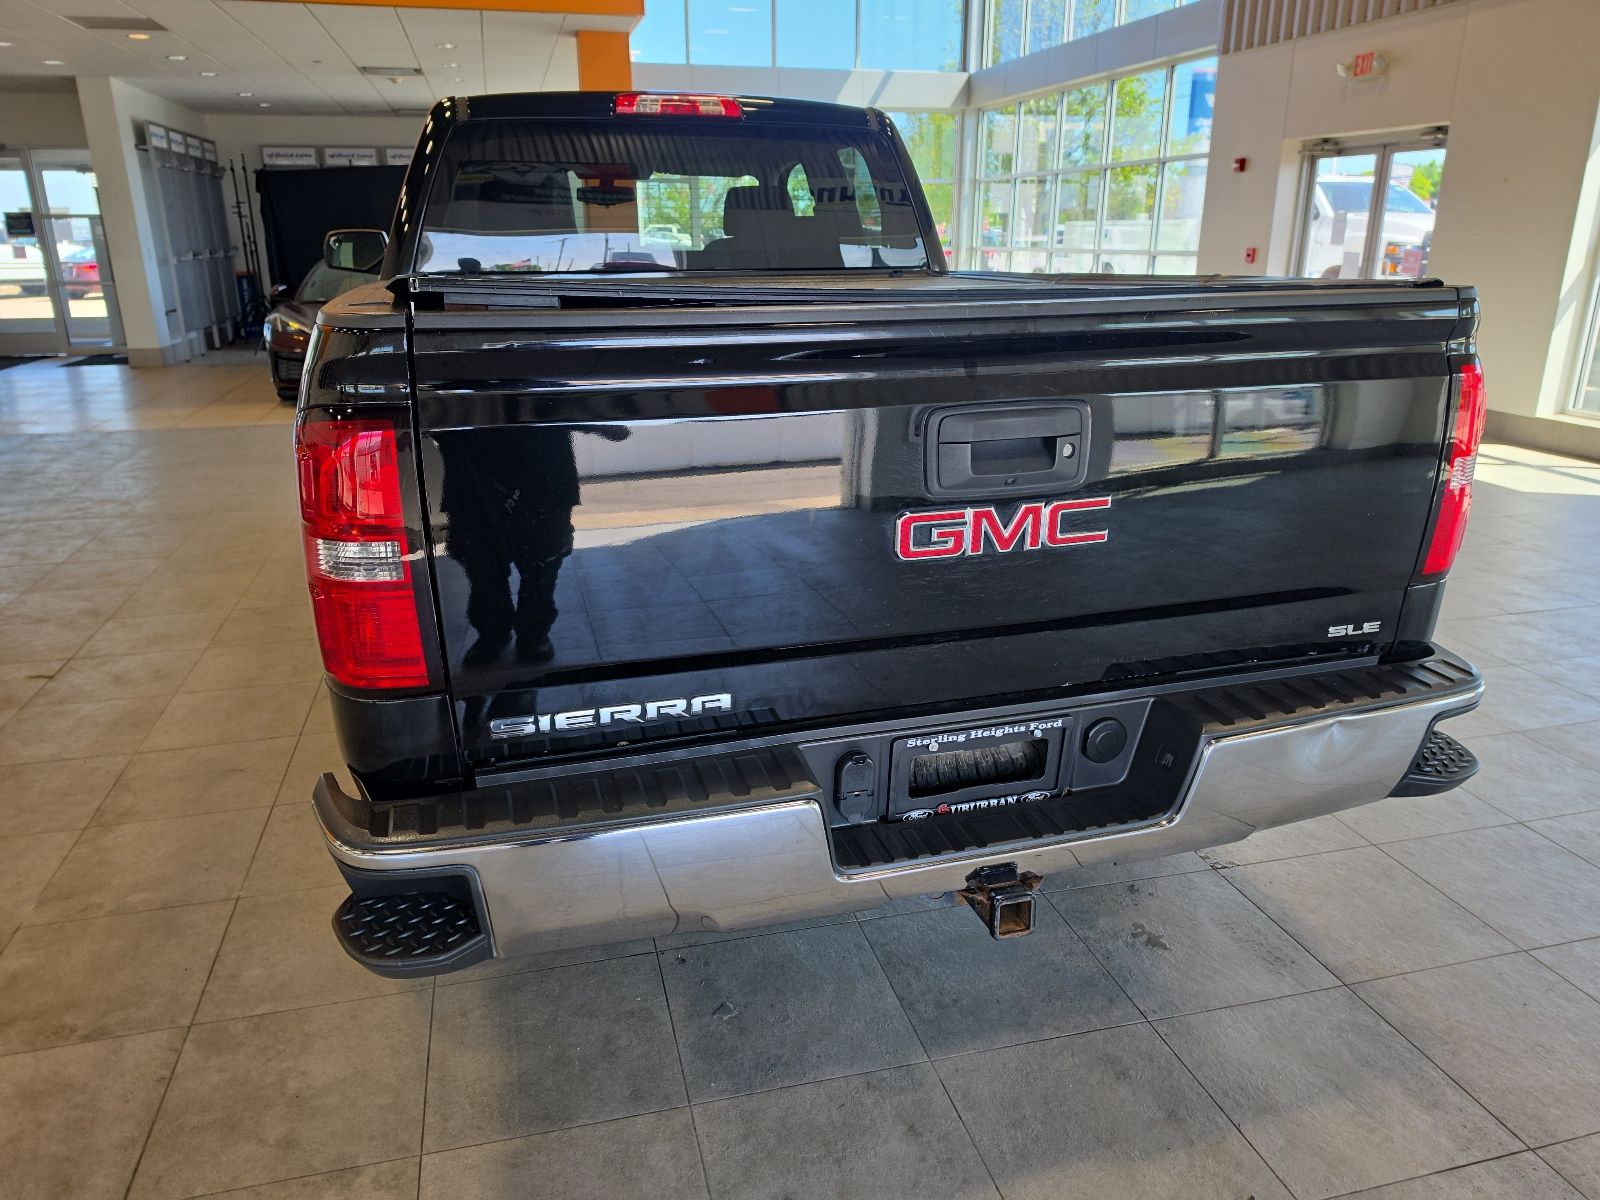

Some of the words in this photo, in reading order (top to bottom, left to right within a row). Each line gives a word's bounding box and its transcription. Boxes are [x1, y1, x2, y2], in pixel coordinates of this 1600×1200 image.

[1353, 52, 1377, 77] EXIT
[896, 496, 1111, 560] GMC
[1327, 621, 1381, 637] SLE
[489, 693, 732, 740] SIERRA
[907, 733, 967, 748] Sterling
[970, 725, 1026, 739] Heights
[1029, 719, 1063, 731] Ford
